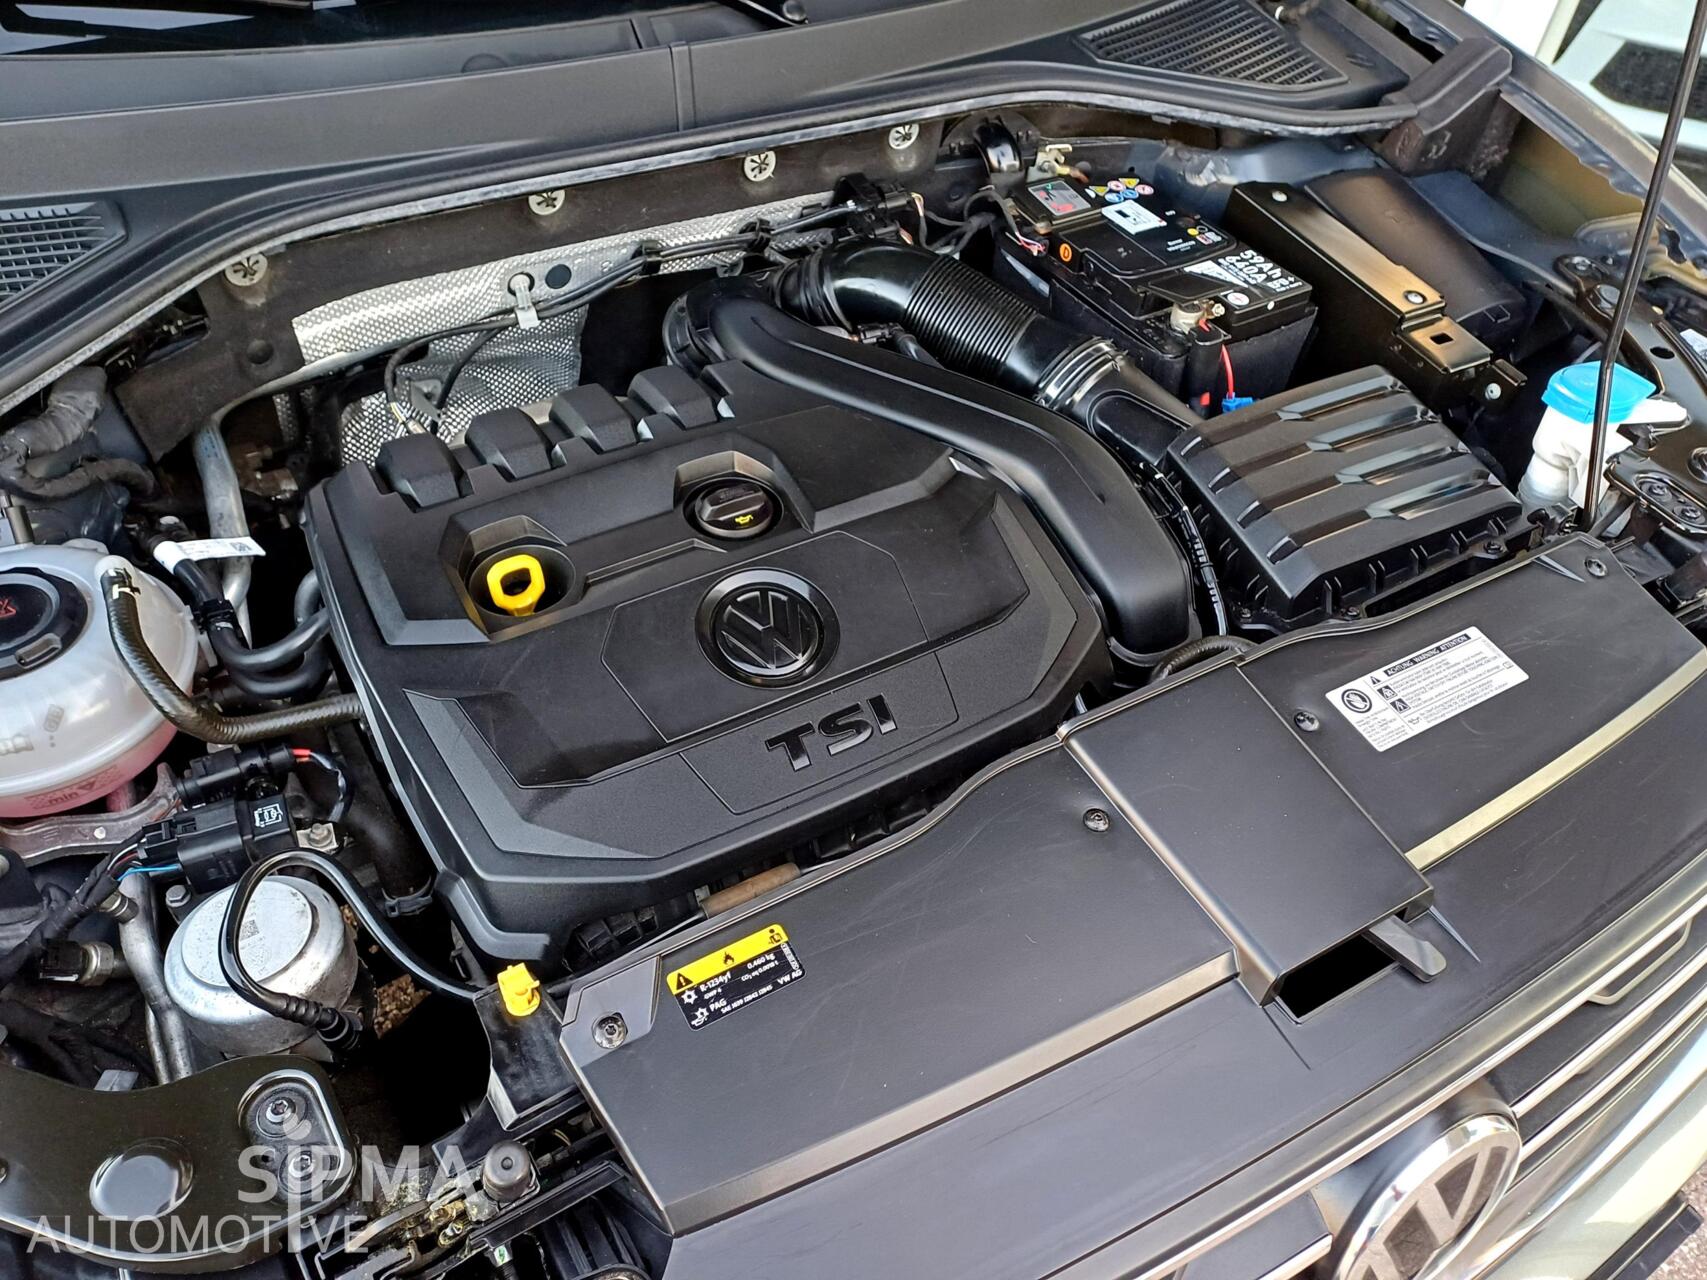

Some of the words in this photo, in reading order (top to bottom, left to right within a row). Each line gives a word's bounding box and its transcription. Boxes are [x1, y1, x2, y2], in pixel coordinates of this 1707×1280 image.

[1240, 249, 1282, 279] 59Ah
[1386, 660, 1413, 675] ACHTUNG
[1412, 647, 1440, 663] WARNING
[1440, 634, 1468, 651] ATTENTION
[765, 693, 898, 772] TSI
[700, 971, 732, 992] R-1234yf
[765, 953, 776, 961] kg
[777, 974, 791, 985] VW
[791, 968, 803, 979] AG
[709, 998, 727, 1012] PAG
